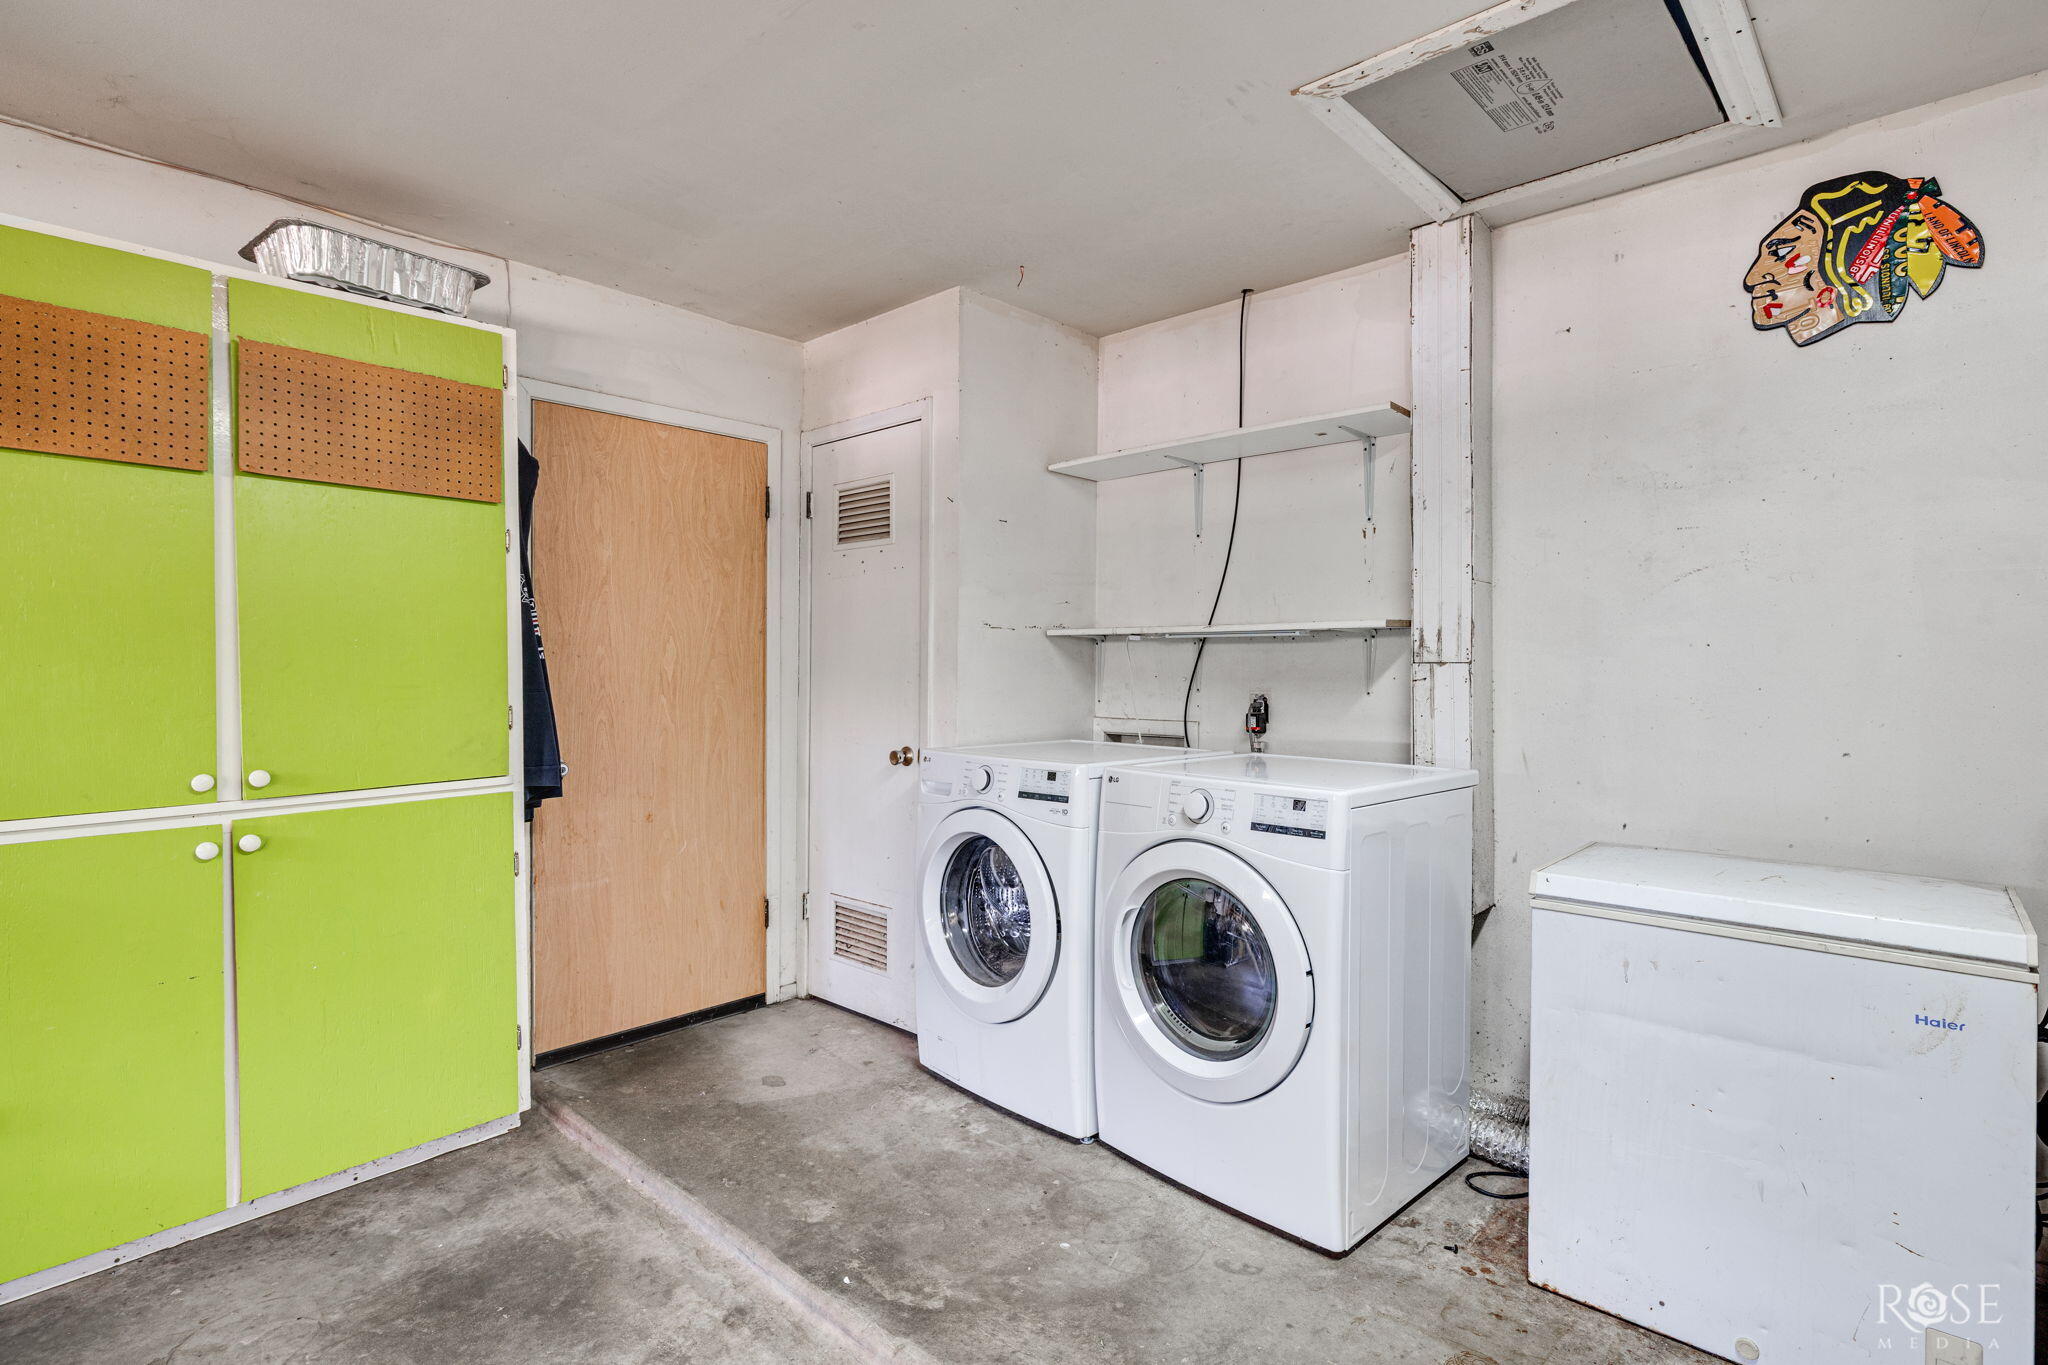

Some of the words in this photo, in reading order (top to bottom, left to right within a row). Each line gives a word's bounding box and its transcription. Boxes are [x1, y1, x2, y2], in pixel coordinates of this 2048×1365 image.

[1924, 212, 1944, 231] LAND
[1938, 228, 1952, 240] OF
[1945, 233, 1975, 264] LINCOLN
[1881, 263, 1892, 301] ILLINOIS
[1914, 1014, 1966, 1032] Haier
